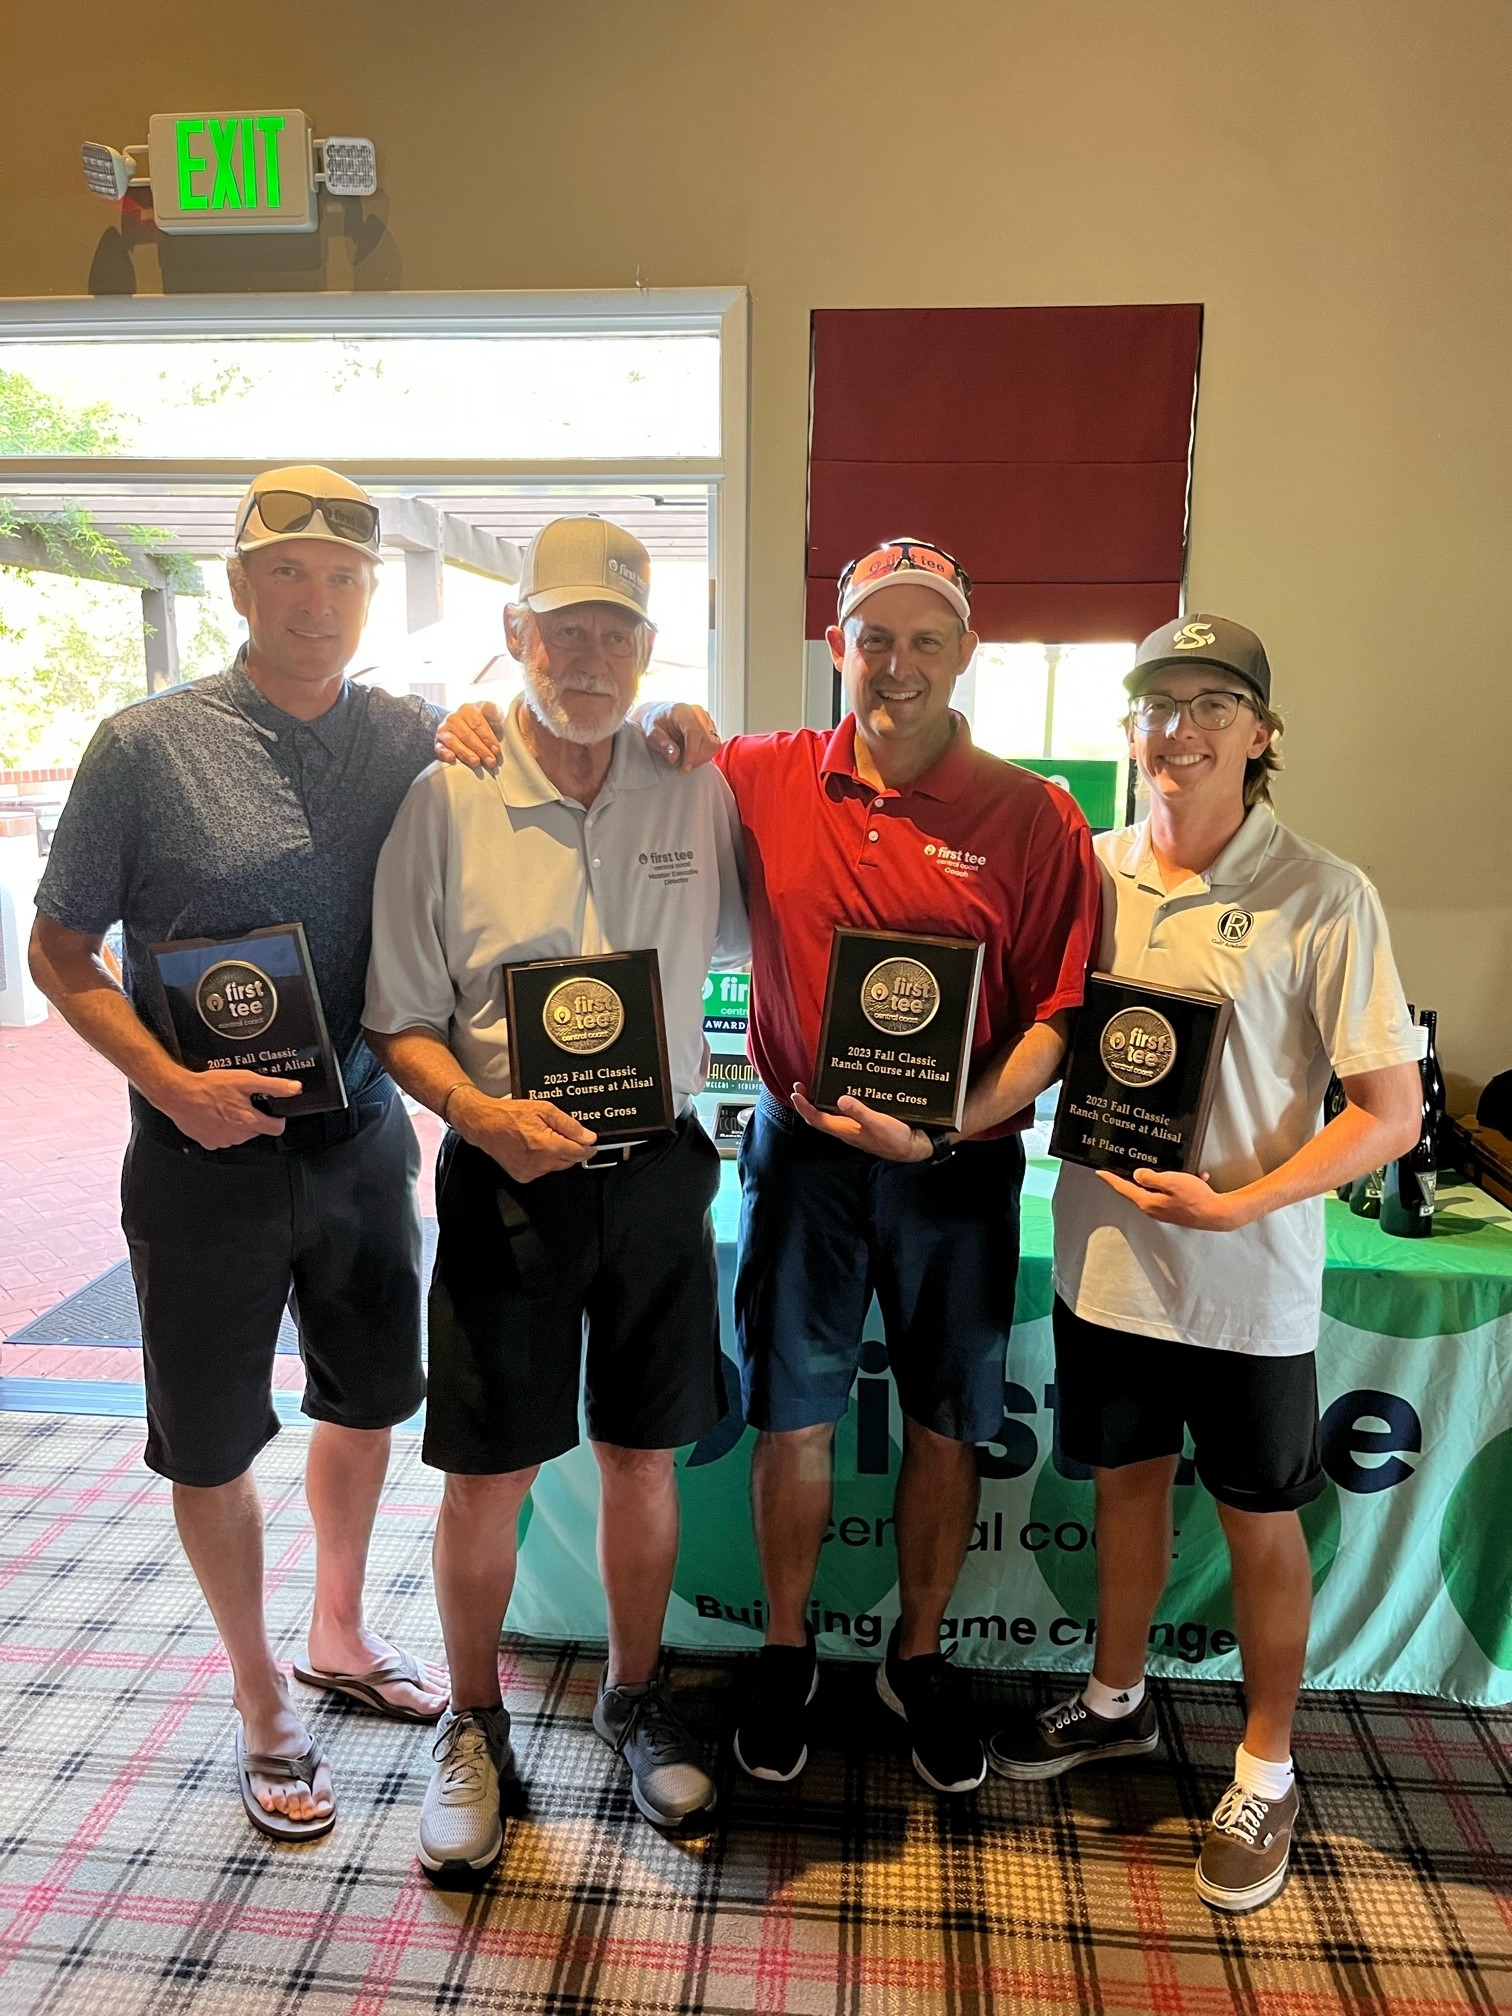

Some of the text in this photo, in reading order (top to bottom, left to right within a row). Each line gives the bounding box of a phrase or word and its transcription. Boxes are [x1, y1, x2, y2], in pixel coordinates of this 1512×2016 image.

[176, 116, 285, 210] EXIT
[921, 556, 945, 573] tee
[650, 851, 693, 863] first tee
[936, 859, 960, 867] central
[938, 846, 987, 866] first tee
[944, 867, 968, 877] Coach
[225, 980, 264, 1002] first
[720, 976, 748, 1002] fir
[893, 976, 932, 999] first
[228, 1000, 263, 1018] tee
[573, 995, 617, 1014] first
[721, 1007, 748, 1016] centr
[891, 994, 924, 1014] tee
[218, 1020, 243, 1029] central
[575, 1012, 612, 1030] tee
[561, 1032, 588, 1042] central
[1129, 1027, 1168, 1052] first
[207, 1047, 299, 1069] 2023 Fall Classic
[271, 1064, 282, 1074] at
[284, 1057, 317, 1072] Alisal
[847, 1046, 938, 1067] 2023 Fall Classic
[1126, 1045, 1160, 1068] tee
[543, 1065, 638, 1085] 2023 Fall Classic
[830, 1057, 951, 1082] Ranch Course at Alisal
[528, 1076, 654, 1100] Ranch Course at Alisal
[705, 1081, 729, 1089] WELERS
[846, 1085, 929, 1106] 1st Place Gross
[570, 1106, 638, 1121] Place Gross
[1085, 1094, 1171, 1126] 2023 Fall Classic
[1069, 1103, 1183, 1144] Ranch Course at Alisal
[1081, 1134, 1158, 1164] 1st Place Gross
[695, 1594, 882, 1648] Buiing
[938, 1615, 1037, 1645] ame
